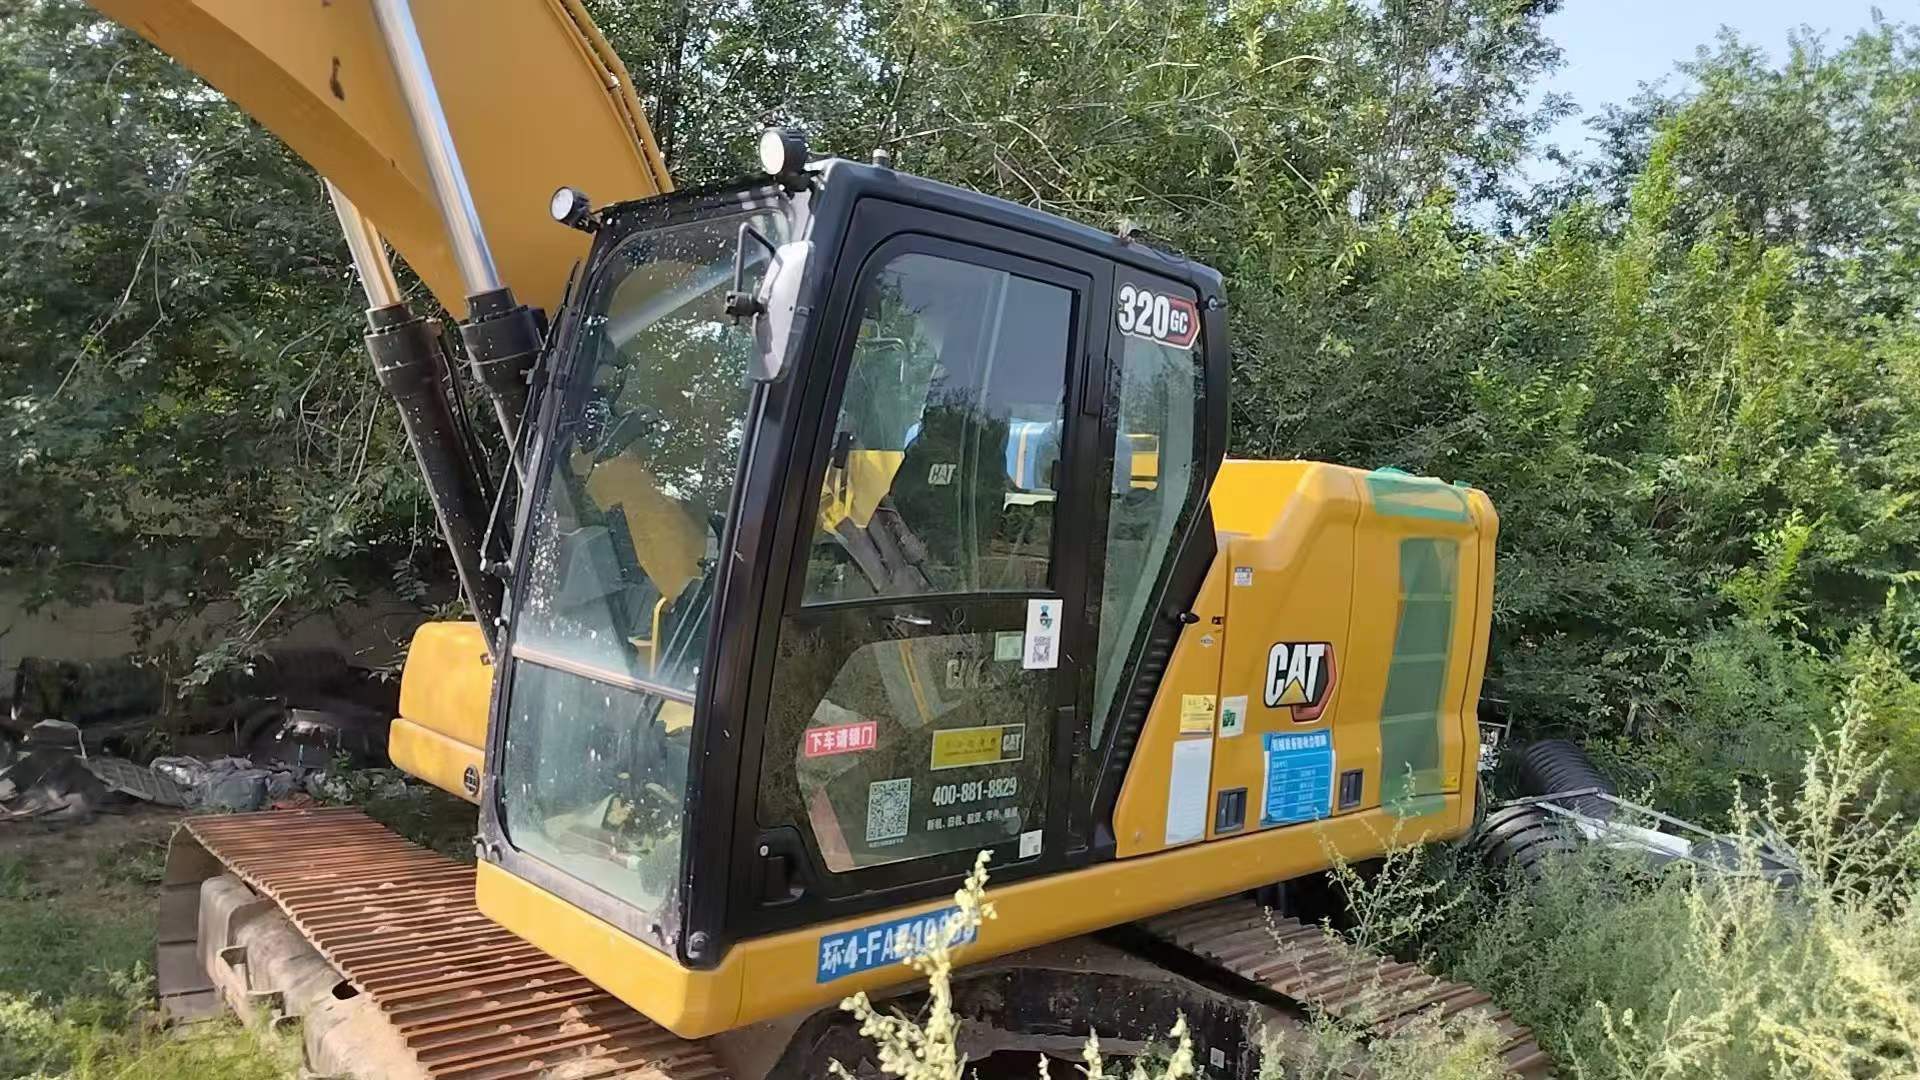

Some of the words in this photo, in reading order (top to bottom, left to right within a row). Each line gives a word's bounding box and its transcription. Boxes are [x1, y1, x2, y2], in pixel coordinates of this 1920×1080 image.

[1118, 285, 1170, 339] 320
[1170, 309, 1189, 334] GC
[928, 463, 957, 485] CAT
[1264, 643, 1326, 707] CAT
[1002, 733, 1022, 752] CAT
[932, 776, 1018, 806] 400-881-8829
